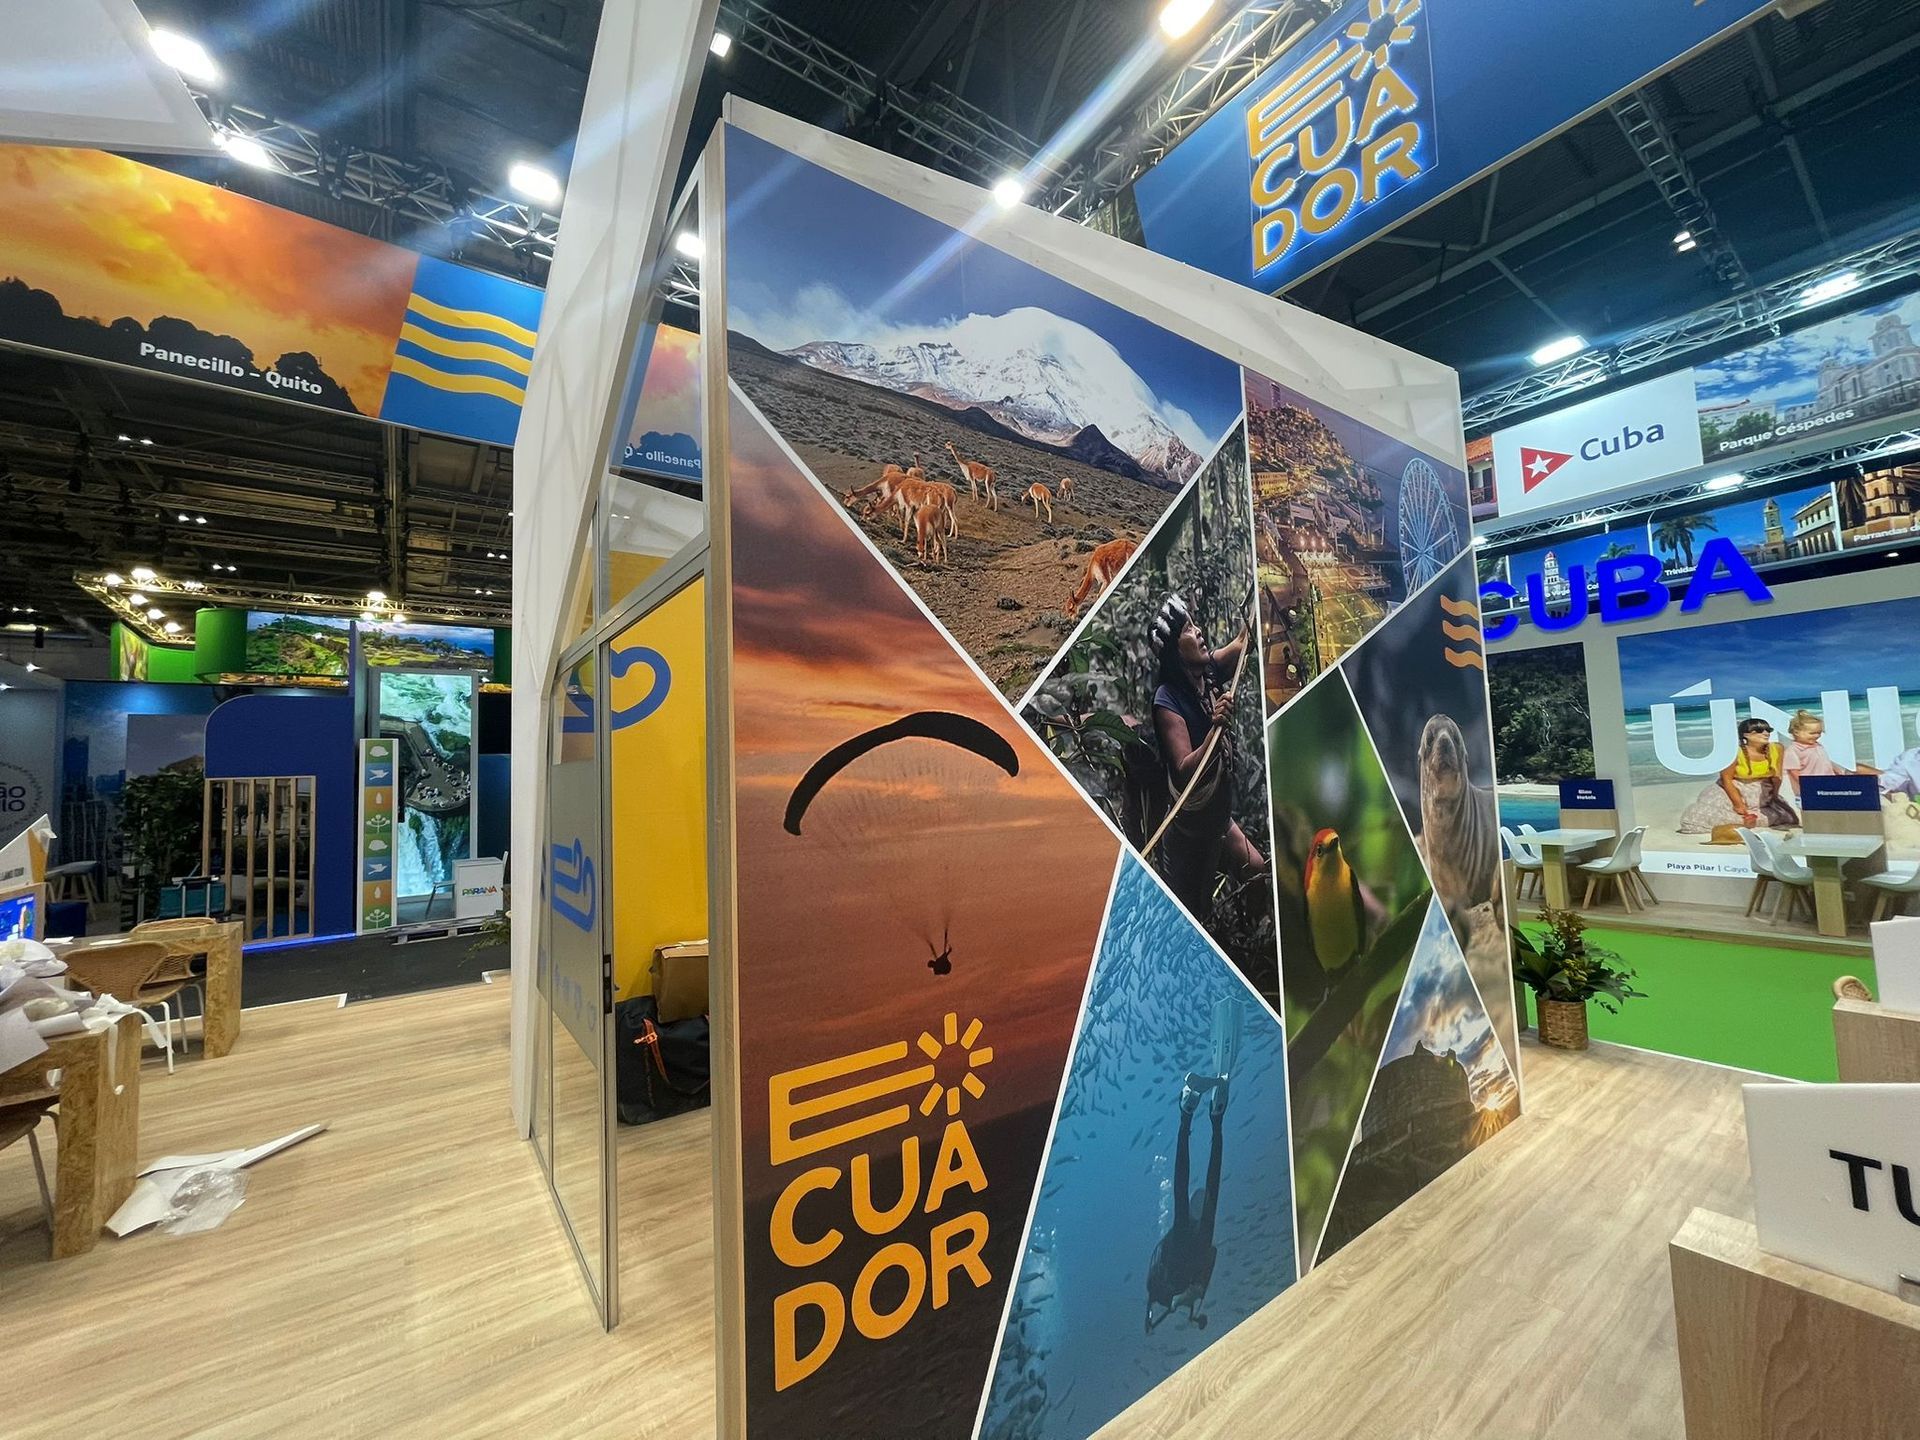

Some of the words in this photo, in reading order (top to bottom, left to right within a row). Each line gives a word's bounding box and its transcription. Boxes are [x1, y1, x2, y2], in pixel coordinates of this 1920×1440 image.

[1252, 121, 1422, 273] DOR
[139, 341, 245, 378] Panecillo
[265, 371, 323, 395] Quito
[1580, 422, 1665, 462] Cuba
[1719, 431, 1773, 453] Parque
[1773, 408, 1855, 437] Céspedes
[1478, 536, 1775, 642] CUBA
[1664, 566, 1698, 577] Trinida
[1650, 678, 1920, 776] ÚNI
[1666, 862, 1691, 871] Playa
[1694, 863, 1715, 871] Pilar
[1723, 865, 1749, 873] Cayo
[769, 1119, 989, 1268] CUA
[773, 1210, 993, 1393] DOR
